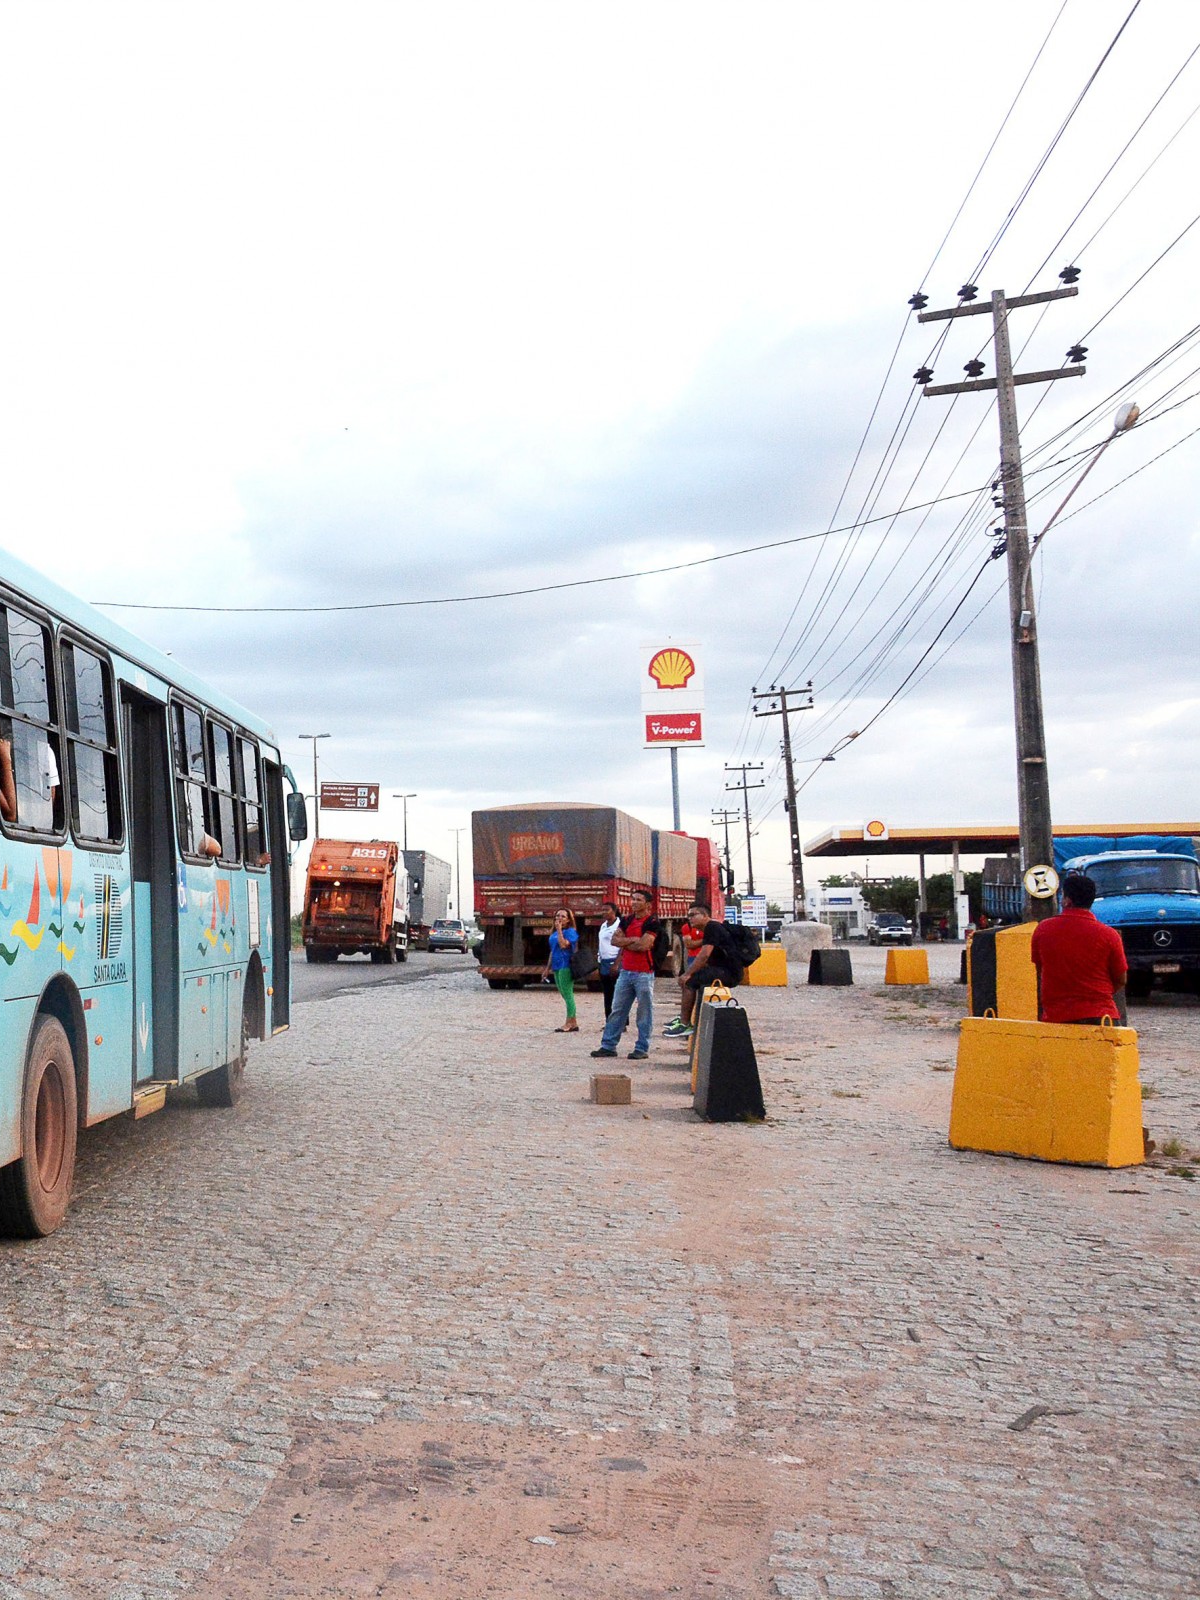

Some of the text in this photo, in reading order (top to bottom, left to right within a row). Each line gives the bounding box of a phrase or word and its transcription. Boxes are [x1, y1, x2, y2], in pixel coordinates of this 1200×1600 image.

[652, 726, 694, 735] V-Power
[352, 848, 387, 859] A319
[94, 964, 110, 983] SANTA
